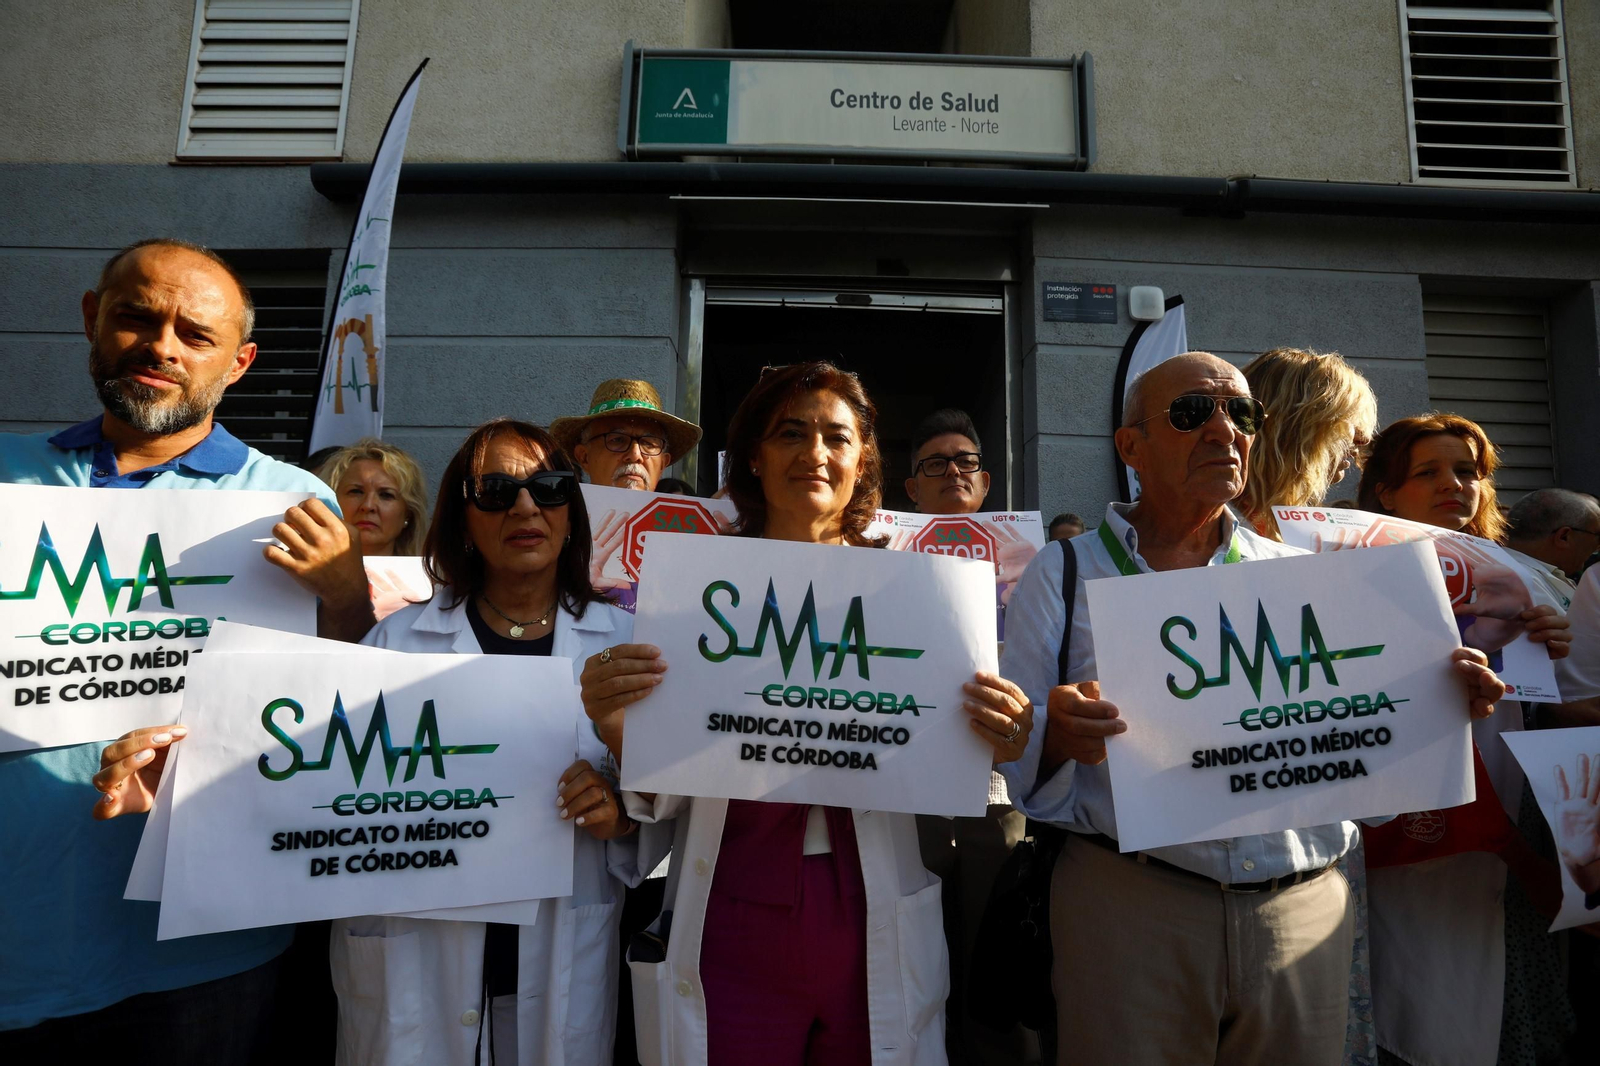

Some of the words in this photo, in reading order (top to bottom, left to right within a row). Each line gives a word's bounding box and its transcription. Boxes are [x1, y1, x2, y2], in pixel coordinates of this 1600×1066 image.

[830, 88, 902, 110] Centro
[909, 91, 934, 111] de
[941, 92, 999, 113] Salud
[893, 115, 947, 133] Levante
[961, 117, 999, 134] Norte
[653, 511, 698, 533] SAS
[1277, 510, 1310, 521] UGT
[934, 527, 973, 543] SAS
[0, 520, 235, 619] MA
[40, 616, 227, 646] CORDOB
[697, 576, 925, 683] SMA
[0, 652, 124, 679] NDICATO
[130, 645, 204, 670] MÉDI
[1159, 597, 1386, 703] SMA
[15, 685, 51, 707] DE
[59, 675, 186, 703] CÓRDOBA
[761, 683, 921, 717] CORDOBA
[1239, 691, 1396, 732] CORDOBA
[258, 688, 501, 789] SMA
[706, 713, 823, 739] SINDICATO
[827, 719, 911, 746] MÉDICO
[740, 743, 767, 763] DE
[771, 742, 878, 771] CÓRDOBA
[1191, 737, 1307, 769] SINDICATO
[1311, 726, 1392, 754] MÉDICO
[1230, 773, 1258, 793] DE
[1261, 758, 1368, 790] CÓRDOBA
[331, 787, 500, 817] CORDOBA
[270, 823, 400, 852] SINDICATO
[404, 817, 490, 843] MÉDICO
[309, 857, 340, 878] DE
[344, 849, 459, 874] CÓRDOBA
